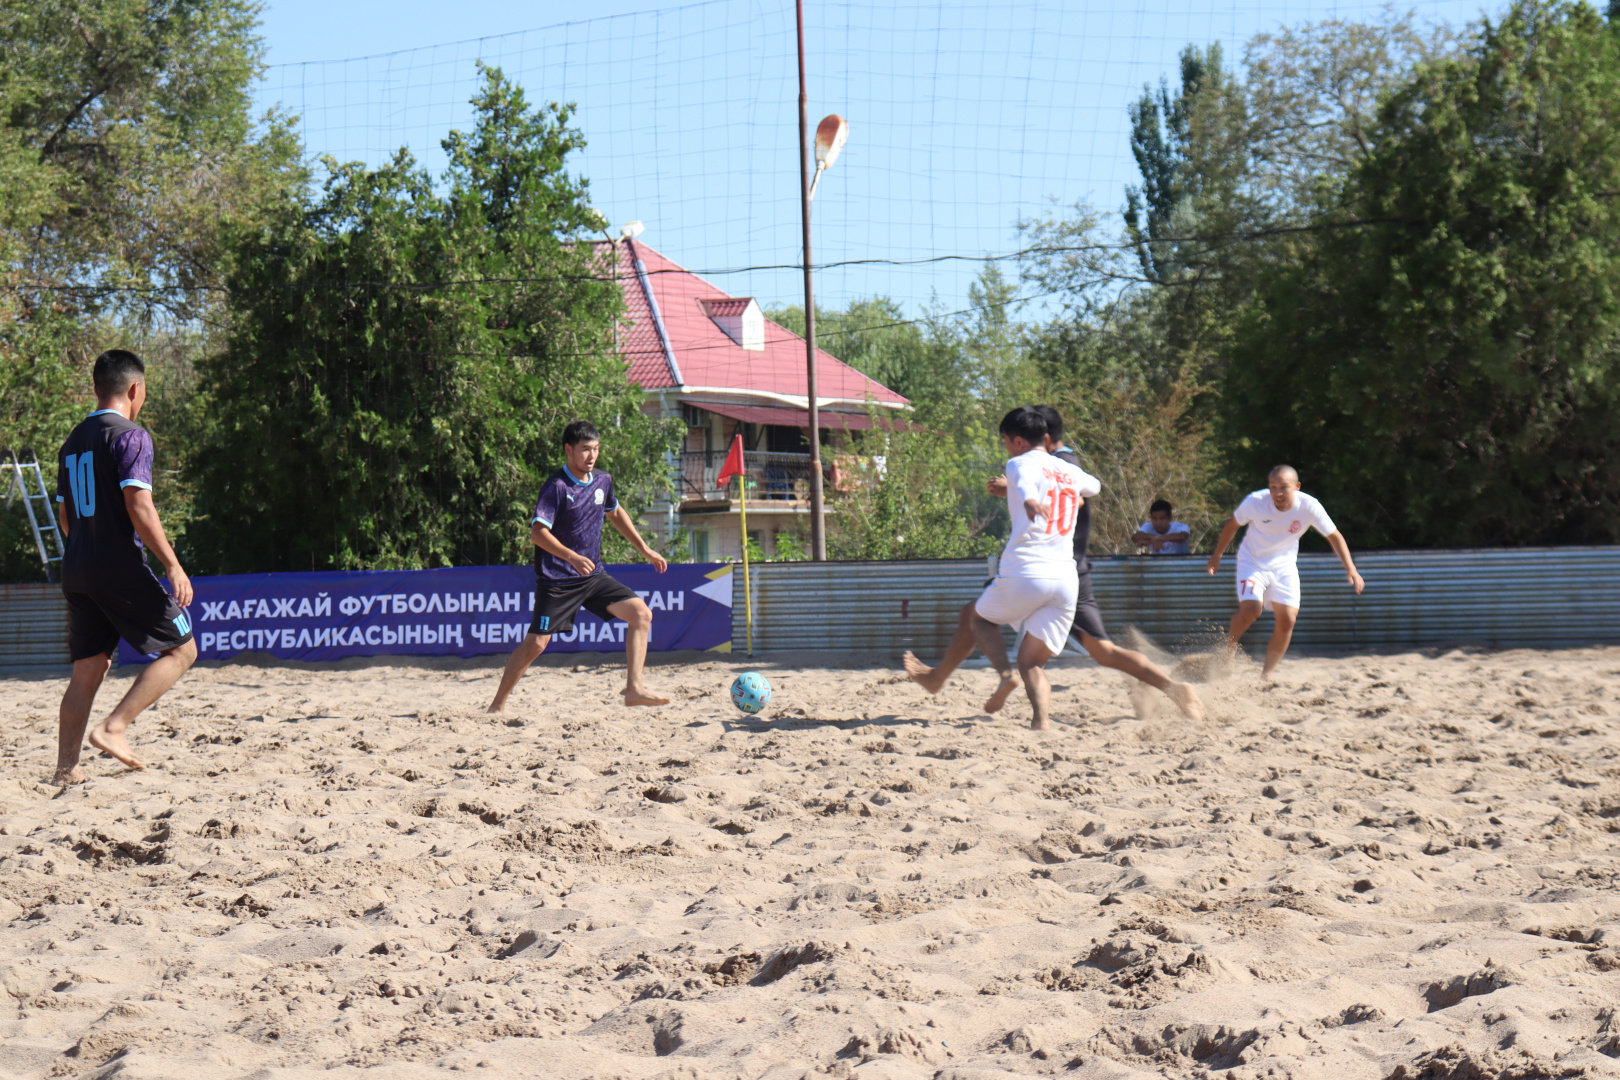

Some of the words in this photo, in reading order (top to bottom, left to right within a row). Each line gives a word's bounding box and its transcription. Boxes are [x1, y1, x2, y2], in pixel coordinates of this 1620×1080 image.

[65, 450, 96, 519] 10
[1045, 486, 1078, 536] 10
[200, 592, 332, 621] ЖАҒАЖАЙ
[339, 591, 520, 617] ФУТБОЛЫНАН
[172, 613, 191, 637] 10
[201, 622, 463, 652] РЕСПУБЛИКАСЫНЫҢ
